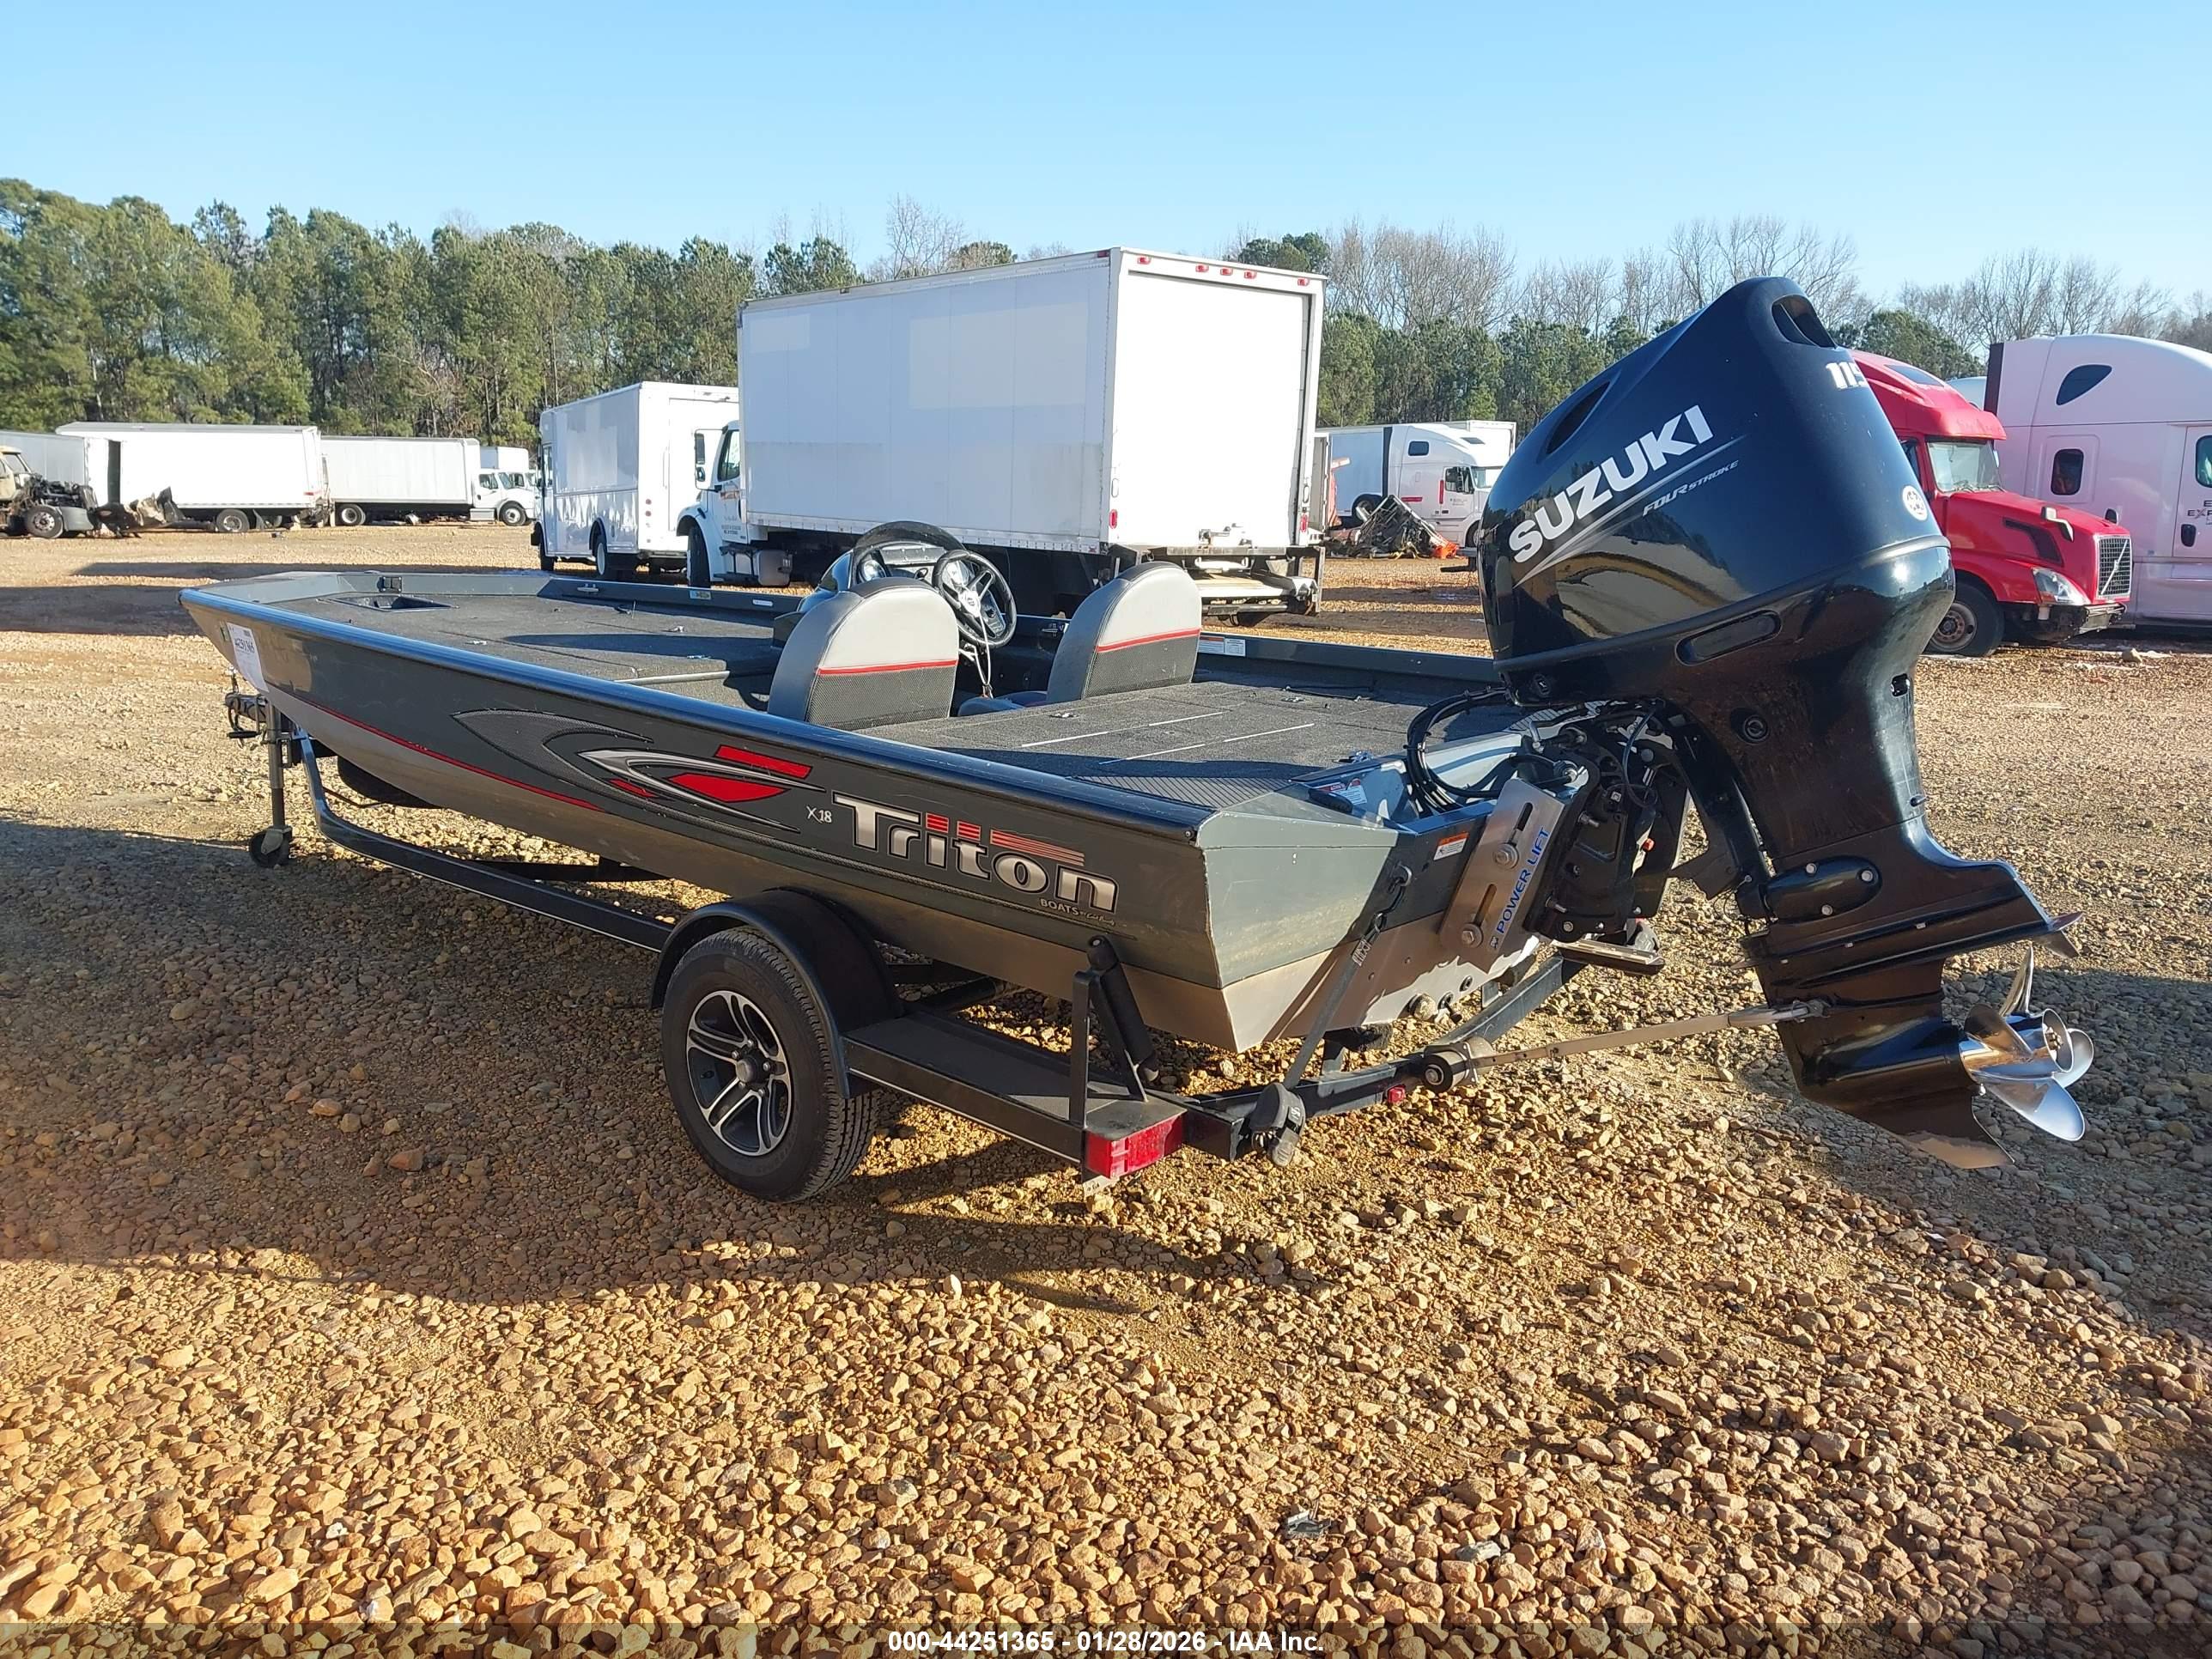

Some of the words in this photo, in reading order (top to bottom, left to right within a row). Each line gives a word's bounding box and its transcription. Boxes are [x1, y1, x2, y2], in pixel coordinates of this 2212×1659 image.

[1509, 404, 1714, 563] SUZUKI
[806, 805, 832, 824] X18
[831, 790, 1119, 915] Triton
[1039, 897, 1079, 916] BOATS
[1496, 868, 1531, 934] POWER
[1527, 827, 1549, 866] LIFT
